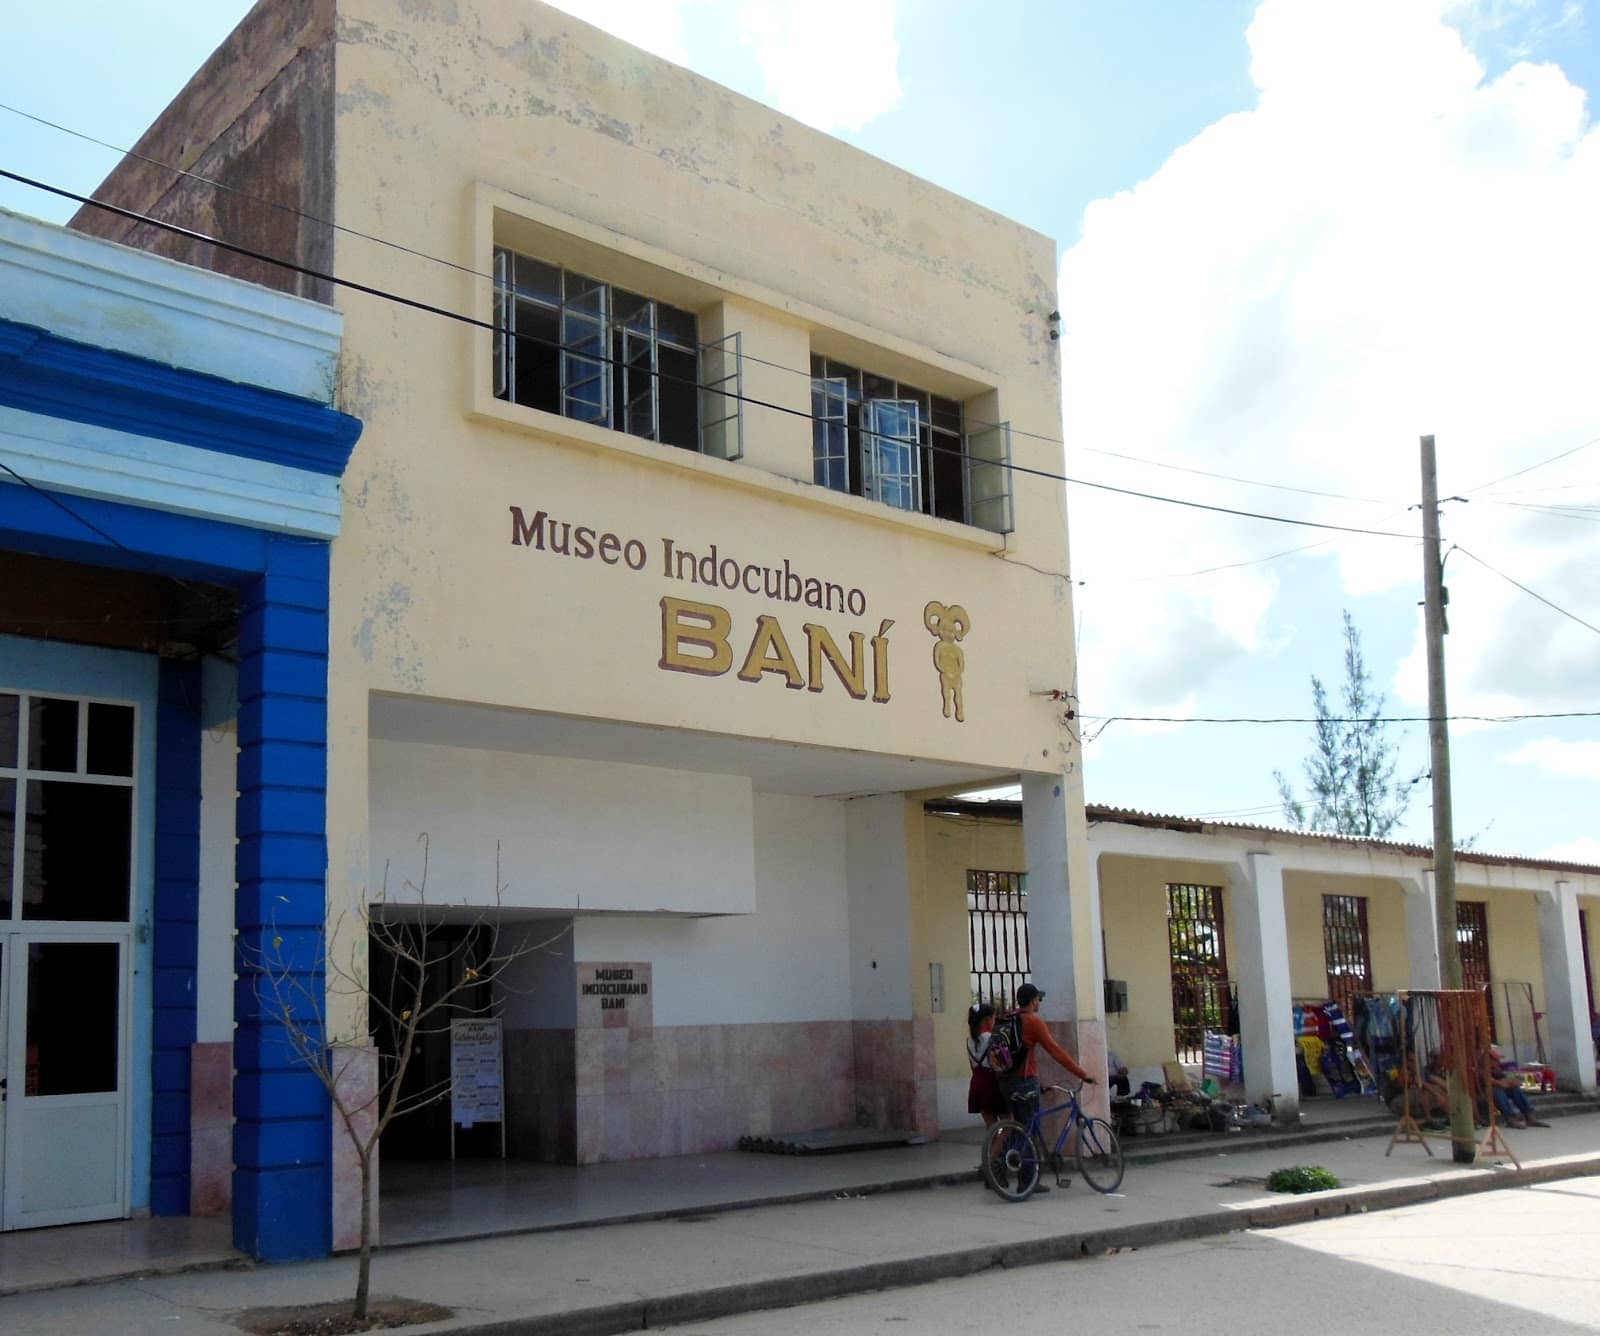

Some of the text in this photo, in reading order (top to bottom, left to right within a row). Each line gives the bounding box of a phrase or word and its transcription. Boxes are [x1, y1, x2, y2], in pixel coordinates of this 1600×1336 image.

[509, 506, 866, 616] Museo Indocubano
[658, 596, 896, 704] BANÍ
[595, 968, 634, 980] MUSEO
